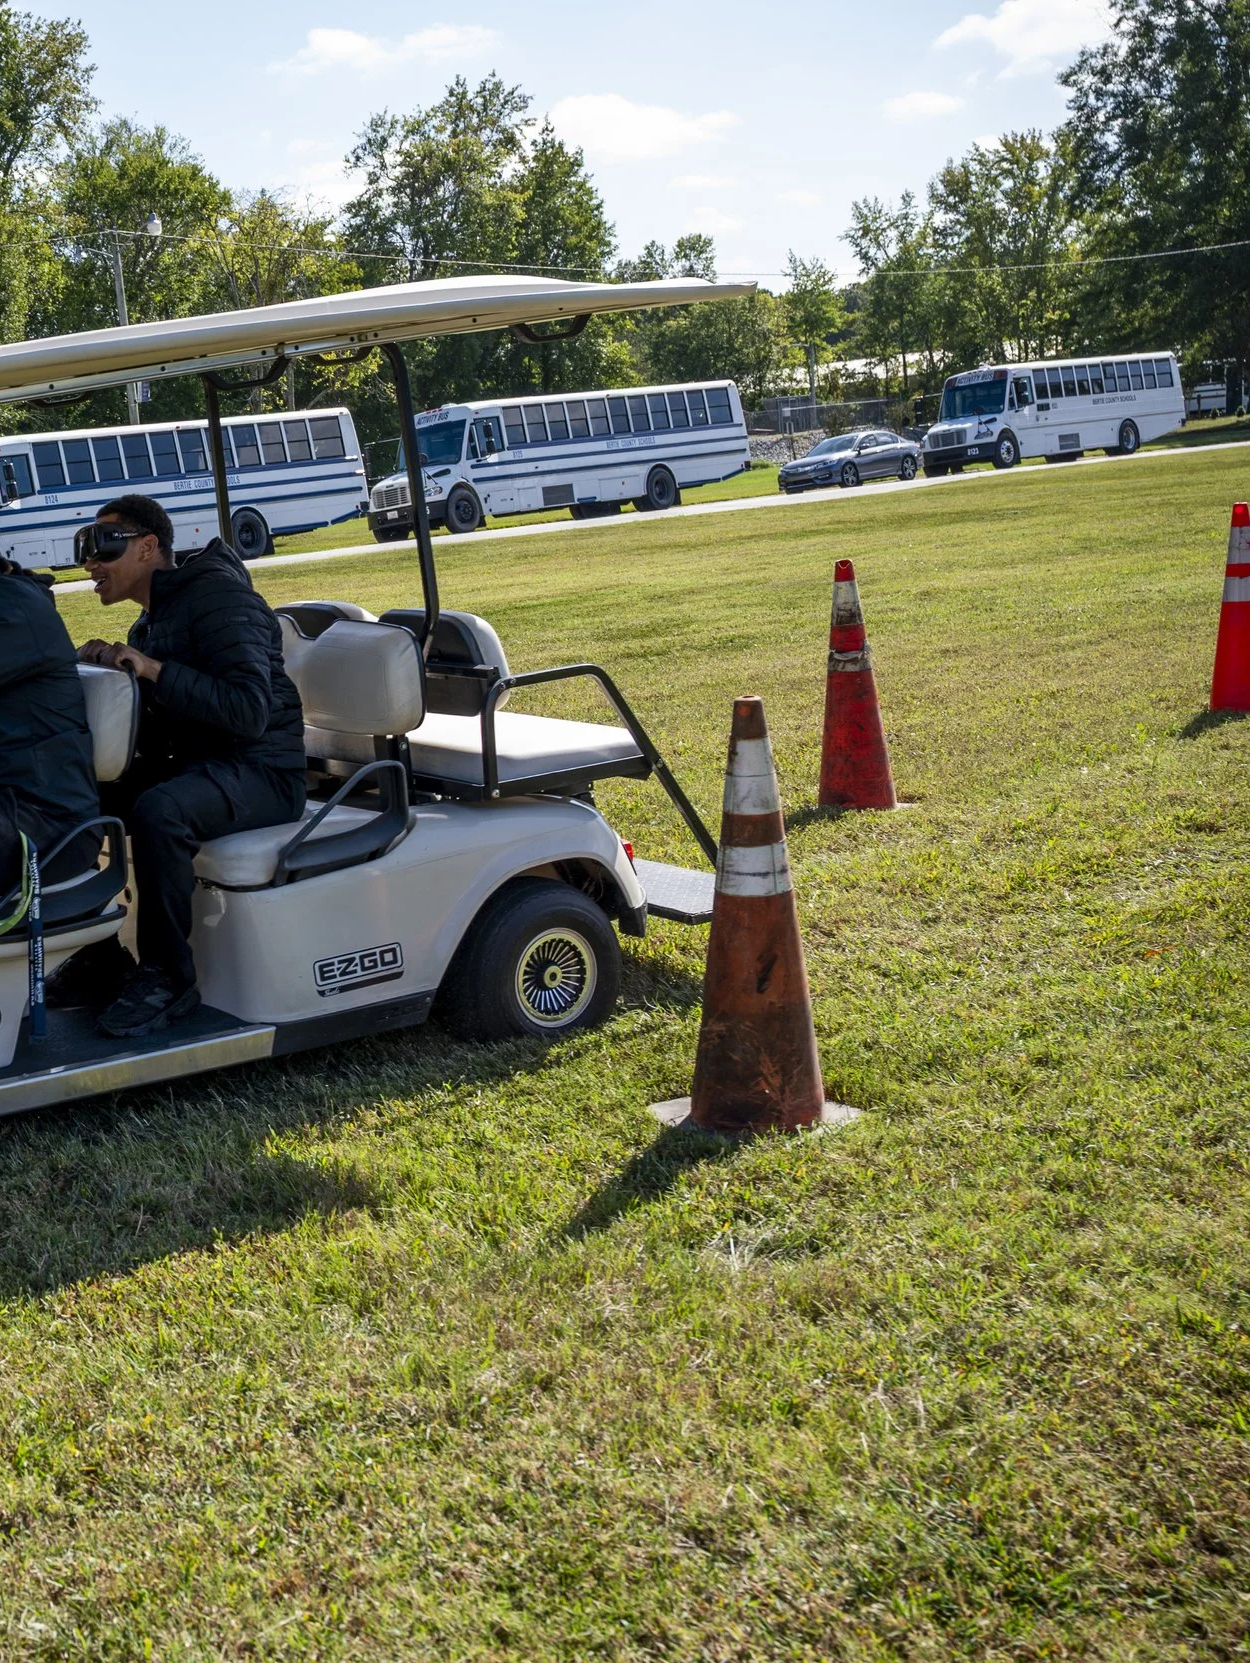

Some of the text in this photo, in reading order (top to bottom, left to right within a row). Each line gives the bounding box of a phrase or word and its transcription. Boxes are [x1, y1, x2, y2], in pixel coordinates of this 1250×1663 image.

[417, 411, 450, 425] ACTIVITY BUS
[621, 439, 636, 448] COUNTY
[174, 481, 192, 490] BERTIE
[194, 479, 214, 488] COUNTY
[44, 494, 59, 505] 8124
